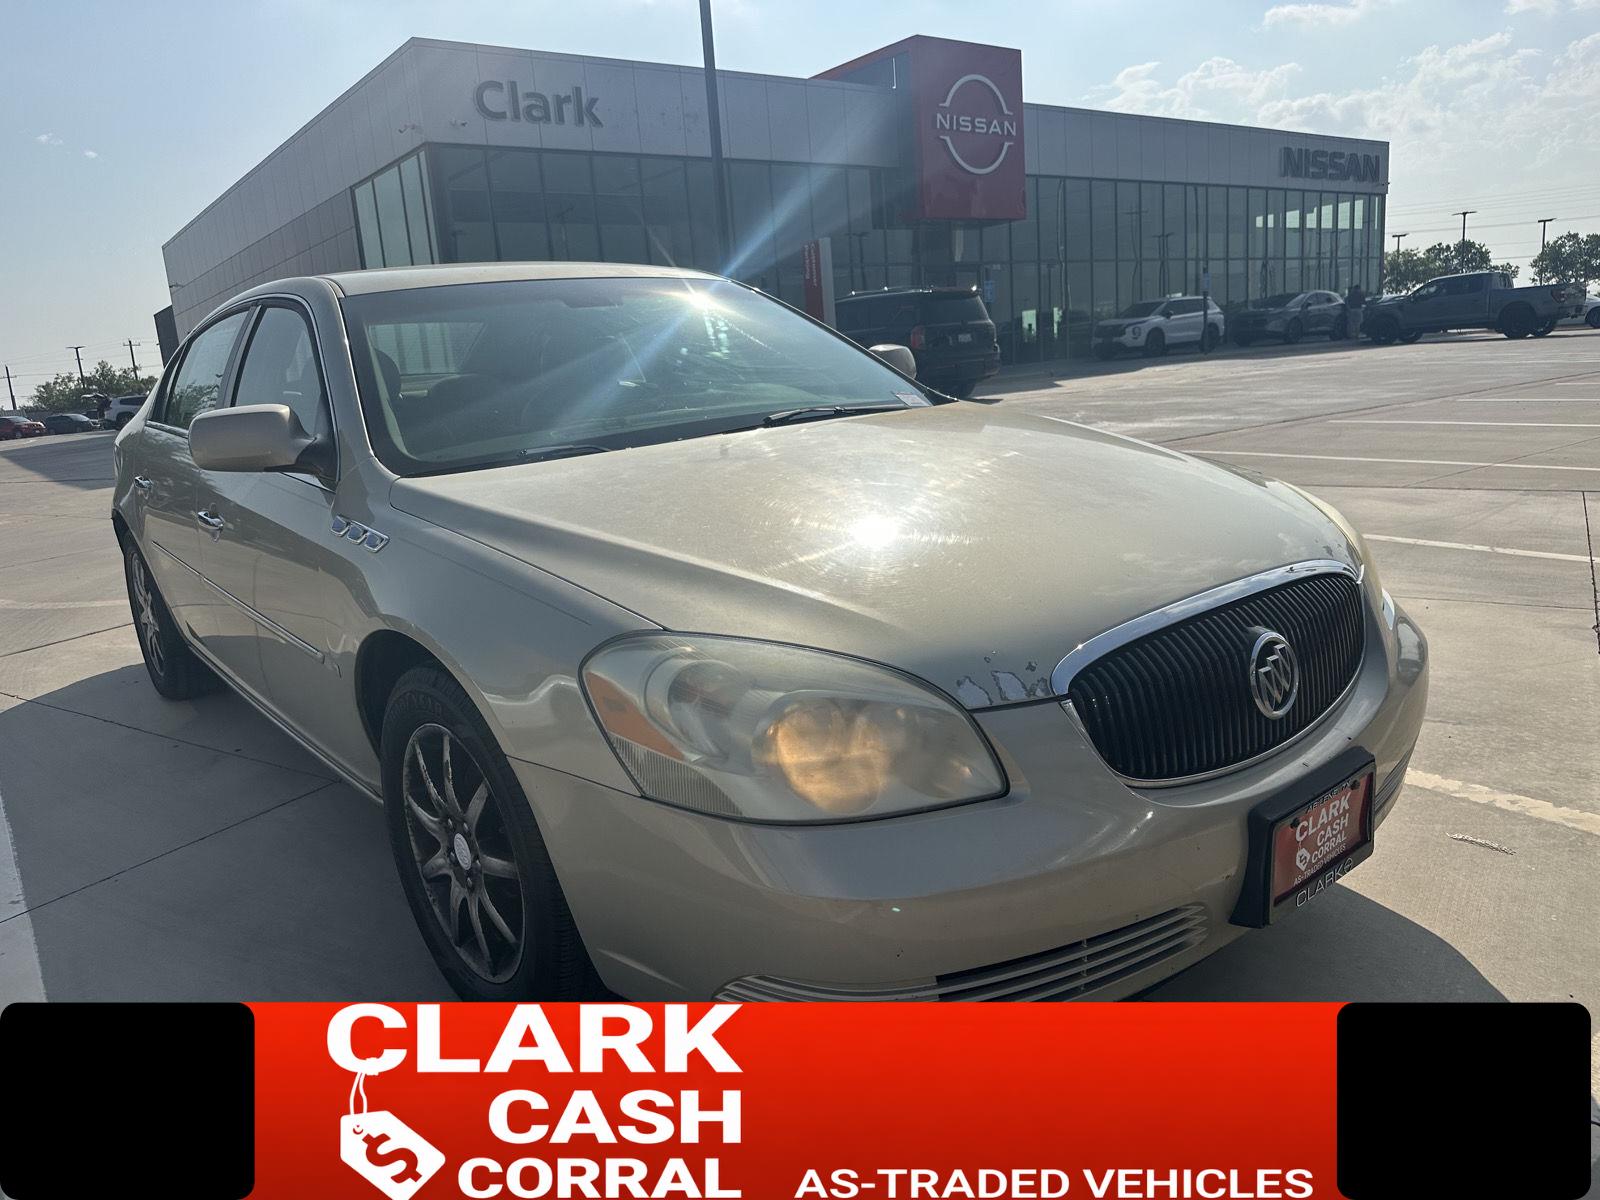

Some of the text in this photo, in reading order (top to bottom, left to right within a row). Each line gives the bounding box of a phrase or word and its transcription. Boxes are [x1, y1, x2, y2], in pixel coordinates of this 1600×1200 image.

[474, 80, 603, 128] Clark
[936, 112, 1016, 136] NISSAN
[1281, 146, 1380, 182] NISSAN
[1295, 792, 1351, 841] CLARK
[1317, 813, 1349, 846] CASH
[1311, 831, 1347, 863] CORRAL
[1295, 862, 1344, 908] CLARK
